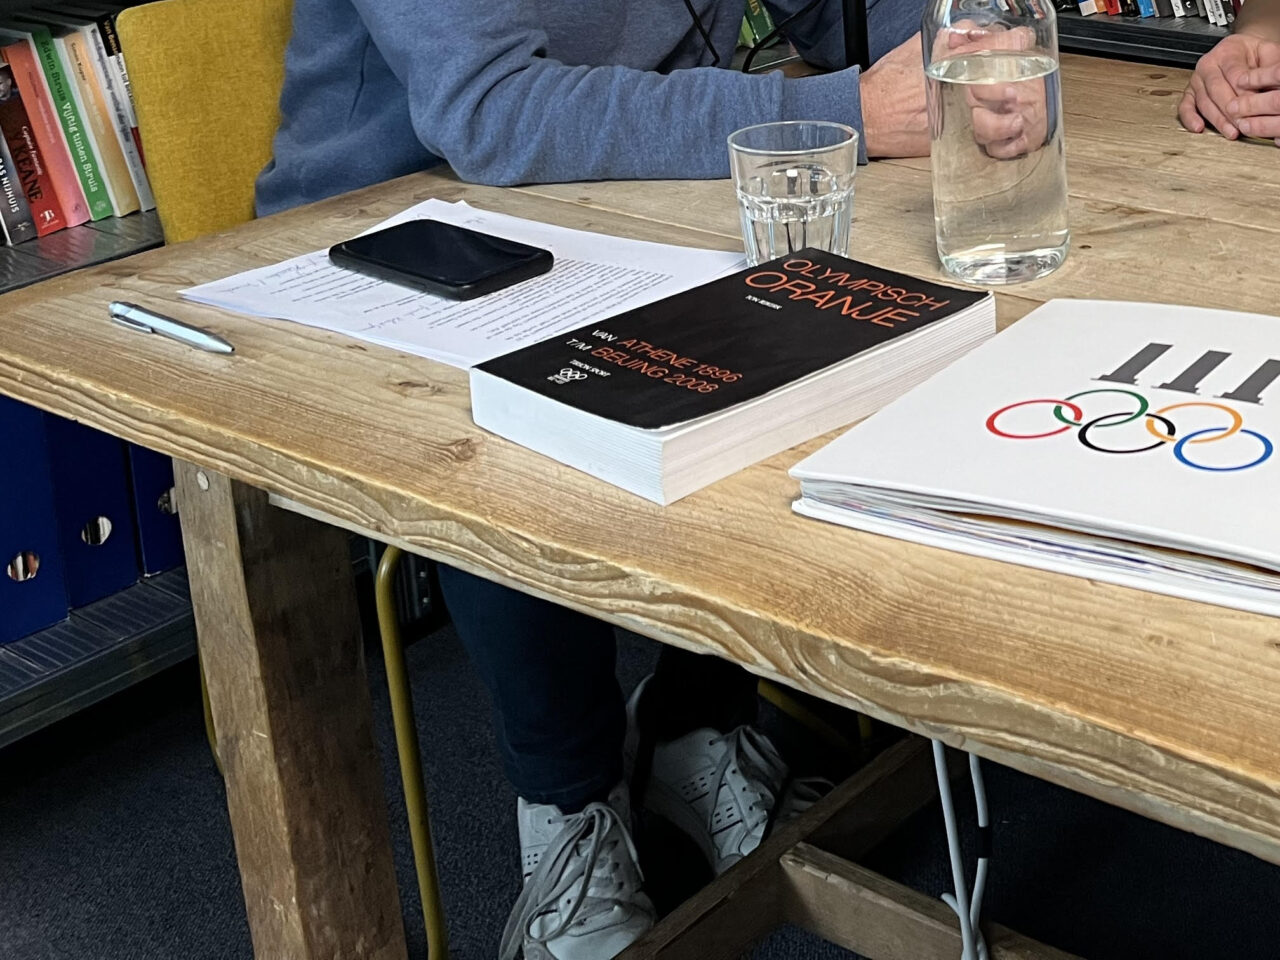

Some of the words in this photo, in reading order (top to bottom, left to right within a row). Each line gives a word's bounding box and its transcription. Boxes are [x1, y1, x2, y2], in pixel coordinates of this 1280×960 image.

[40, 41, 58, 69] Edwin
[50, 72, 65, 101] Struis
[61, 102, 81, 132] Vijftig
[72, 134, 88, 162] tinten
[82, 163, 98, 192] Struis
[11, 145, 43, 203] KEANE
[745, 269, 918, 330] ORANJE
[782, 257, 949, 312] OLYMPISCH
[565, 338, 593, 352] T/M
[590, 346, 668, 379] BEIJING
[664, 374, 719, 394] 2008
[592, 329, 618, 342] VAN
[616, 339, 697, 369] ATHENE
[693, 363, 743, 384] 1896
